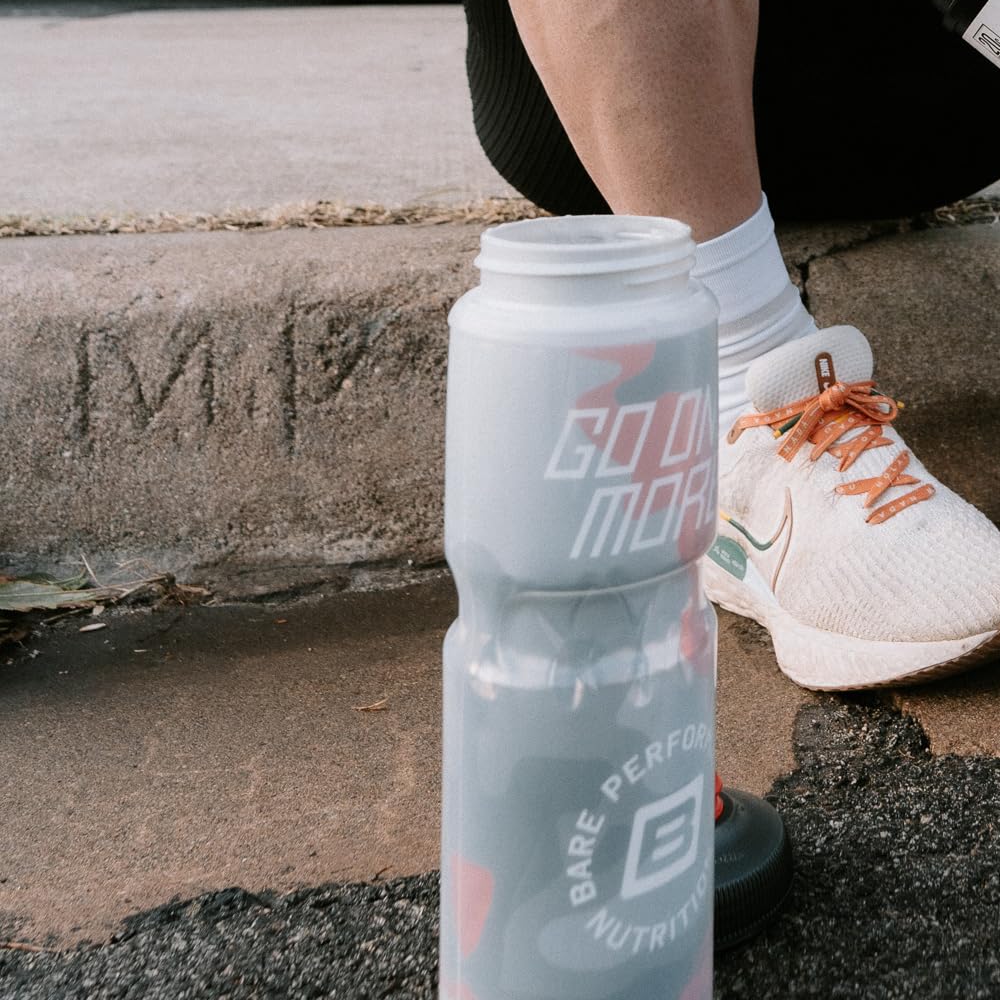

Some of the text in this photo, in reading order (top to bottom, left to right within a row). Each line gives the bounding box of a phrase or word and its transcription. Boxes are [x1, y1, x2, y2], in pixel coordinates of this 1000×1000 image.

[544, 400, 657, 480] GO
[566, 808, 605, 907] BARE
[585, 855, 709, 953] NUTRITIO
